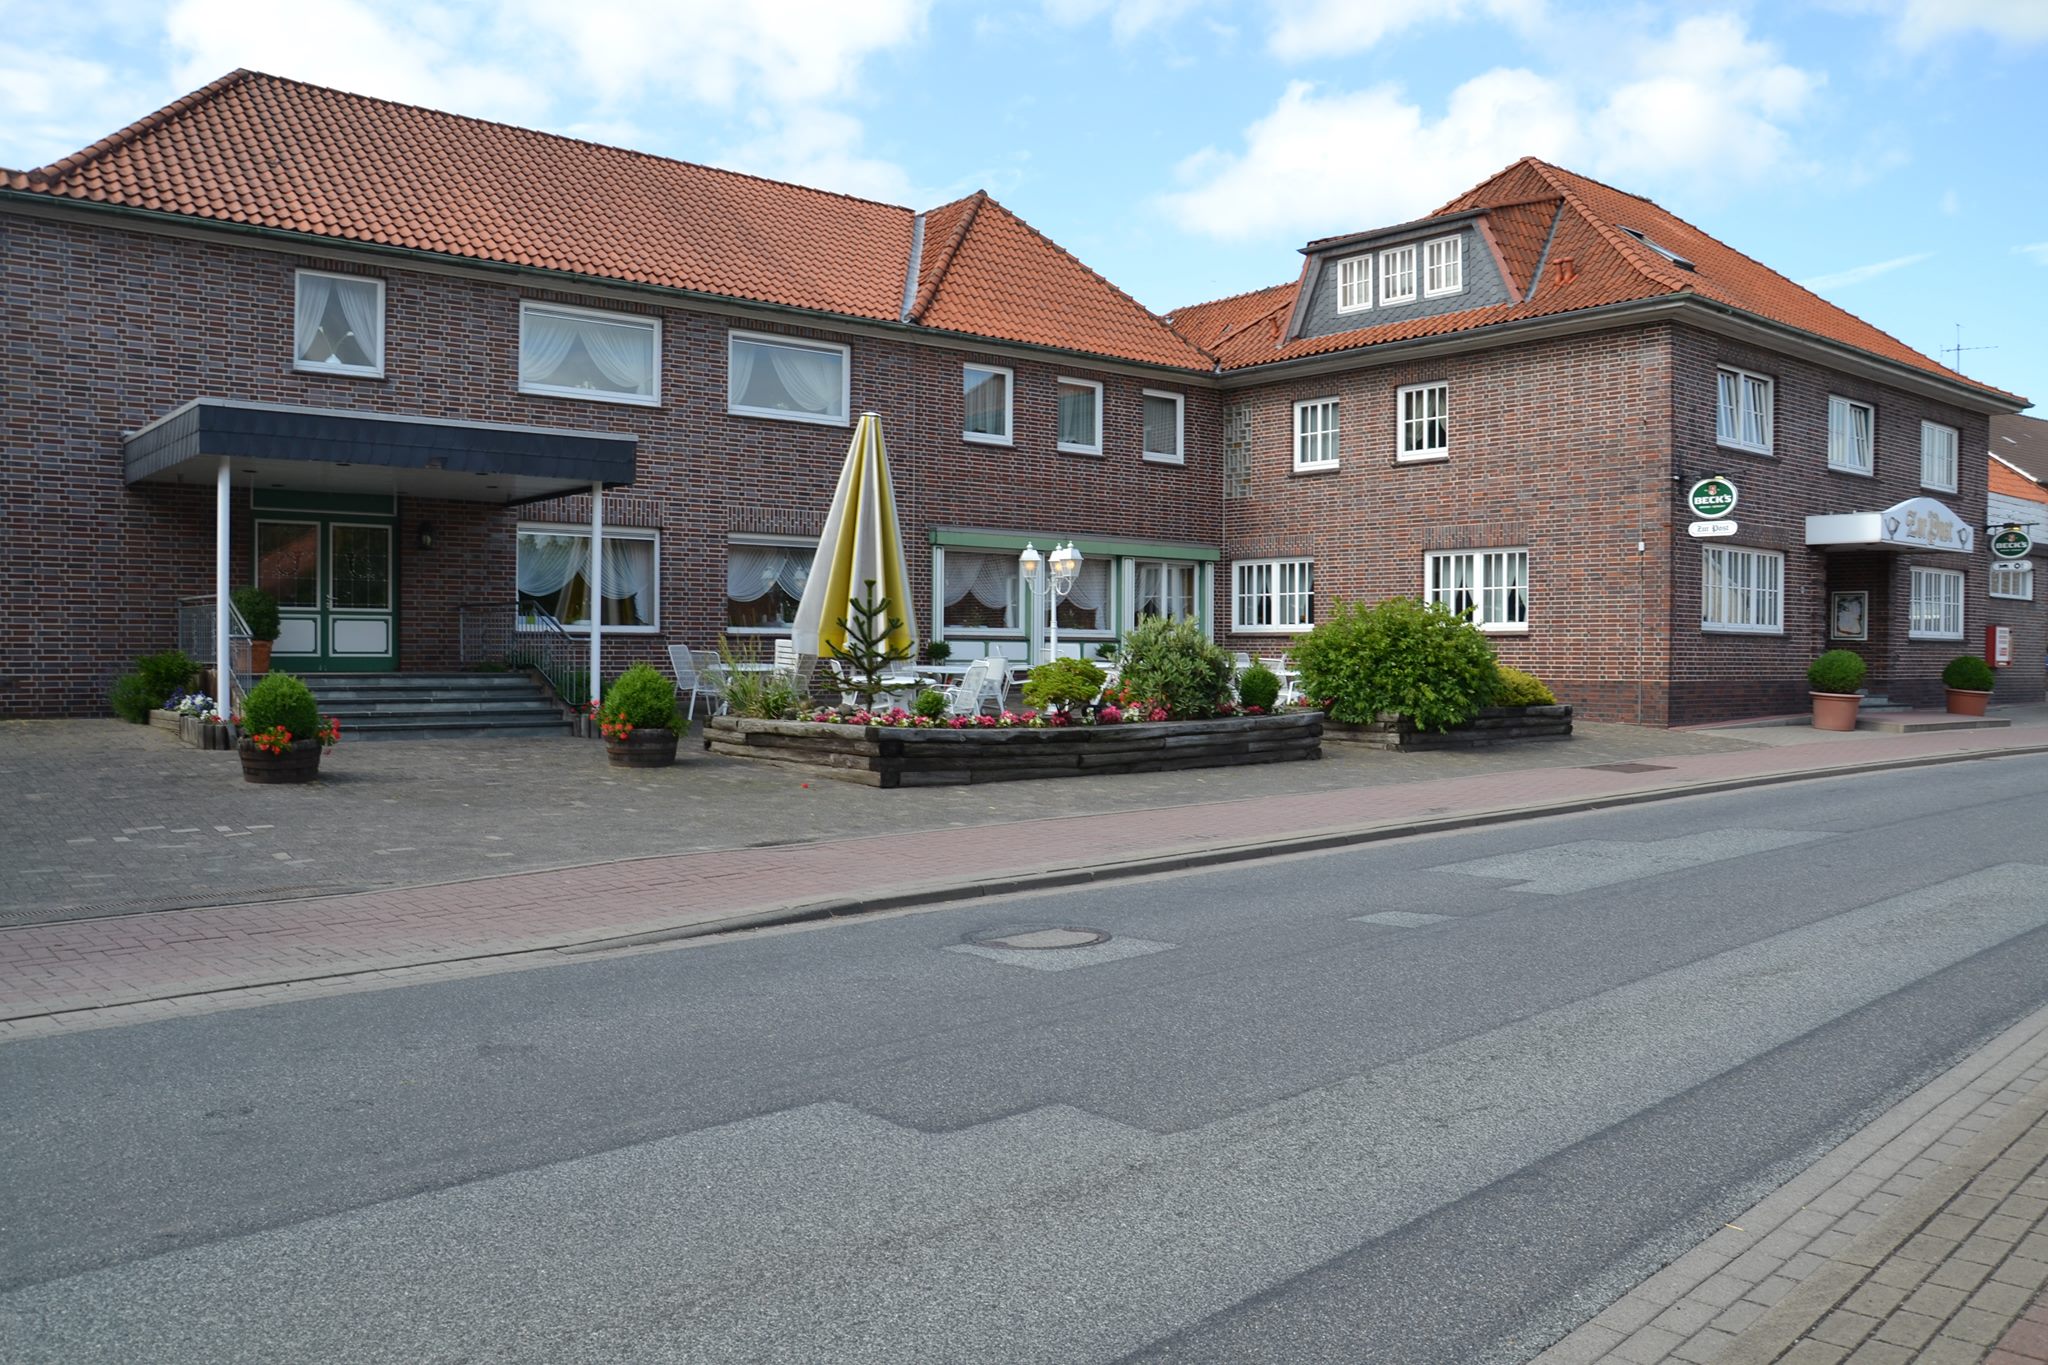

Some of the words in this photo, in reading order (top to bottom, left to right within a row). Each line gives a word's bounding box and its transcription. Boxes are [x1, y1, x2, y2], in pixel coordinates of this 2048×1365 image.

[1694, 494, 1732, 505] BECK'S
[1712, 524, 1729, 533] Post
[1996, 541, 2027, 549] BECK'S
